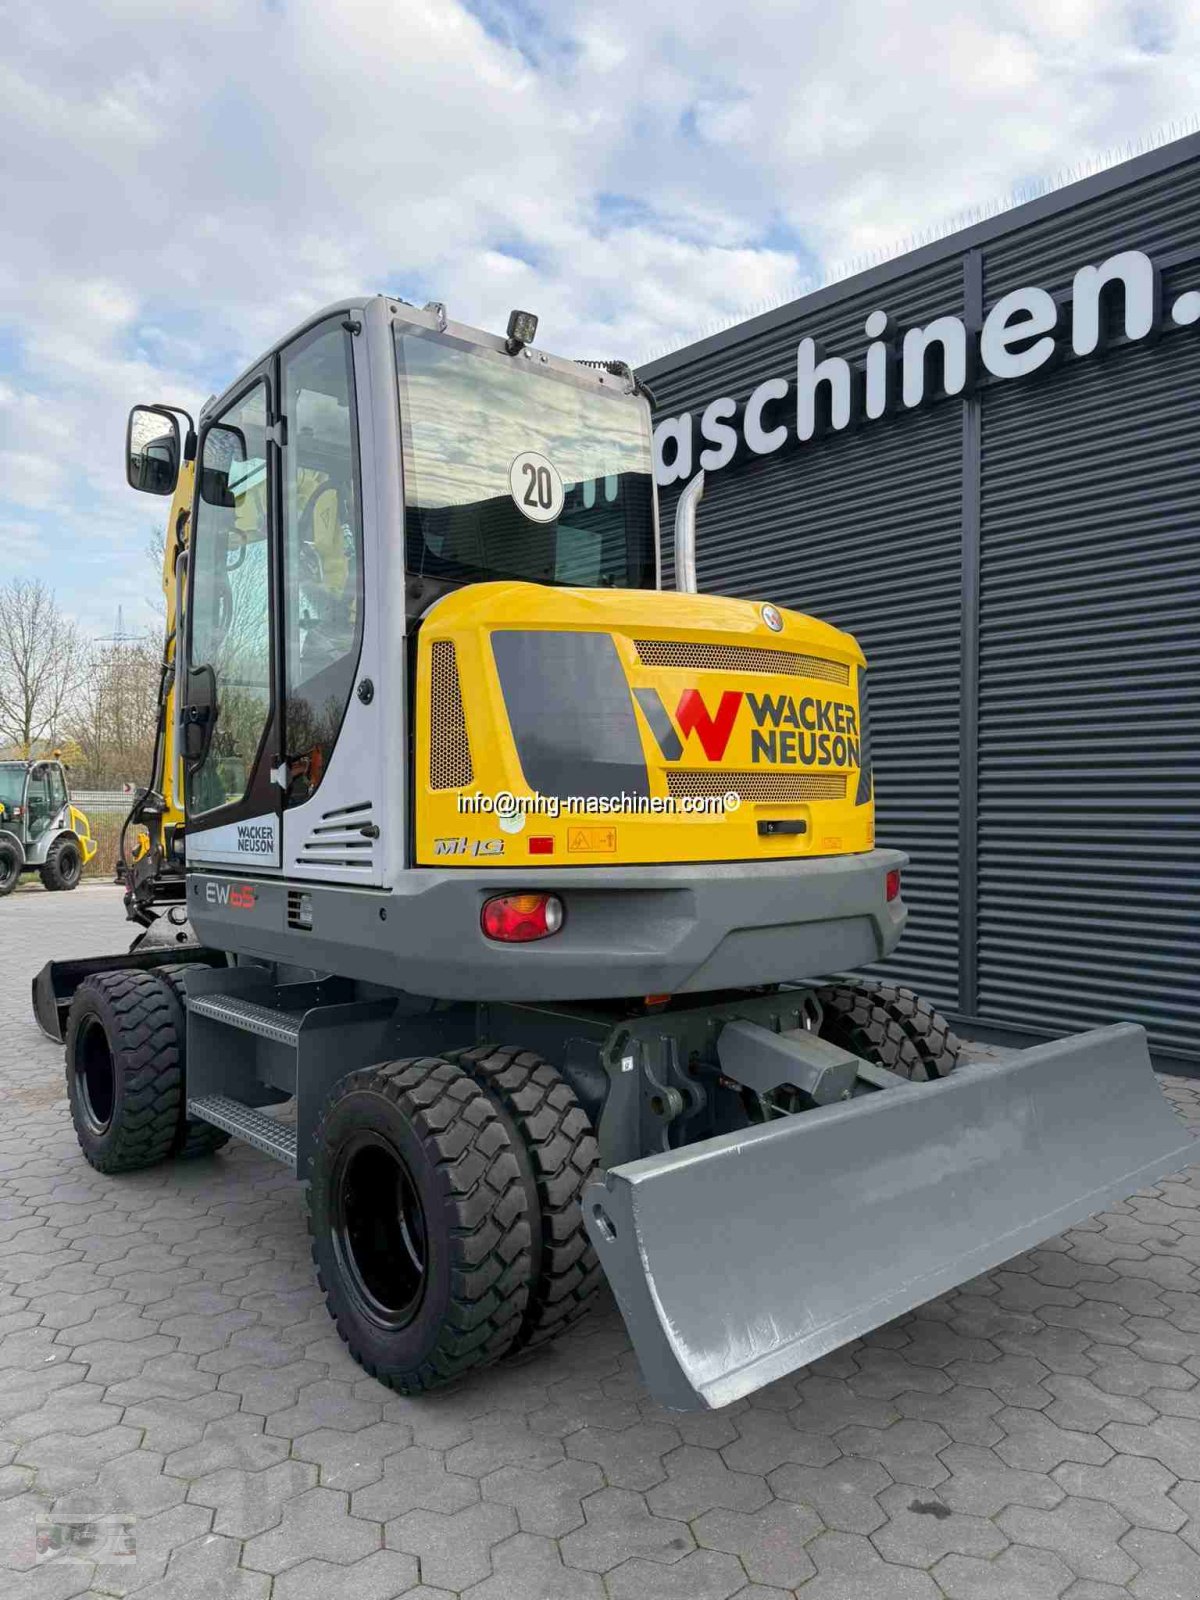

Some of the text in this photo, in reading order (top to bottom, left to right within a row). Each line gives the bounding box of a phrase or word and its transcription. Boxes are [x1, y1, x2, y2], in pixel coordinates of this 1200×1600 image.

[522, 463, 552, 509] 20
[745, 692, 859, 736] WACKER
[751, 729, 861, 768] NEUSON
[237, 826, 273, 839] WACKER
[237, 839, 274, 853] NEUSON
[434, 837, 505, 857] MHG
[206, 882, 256, 908] EW65
